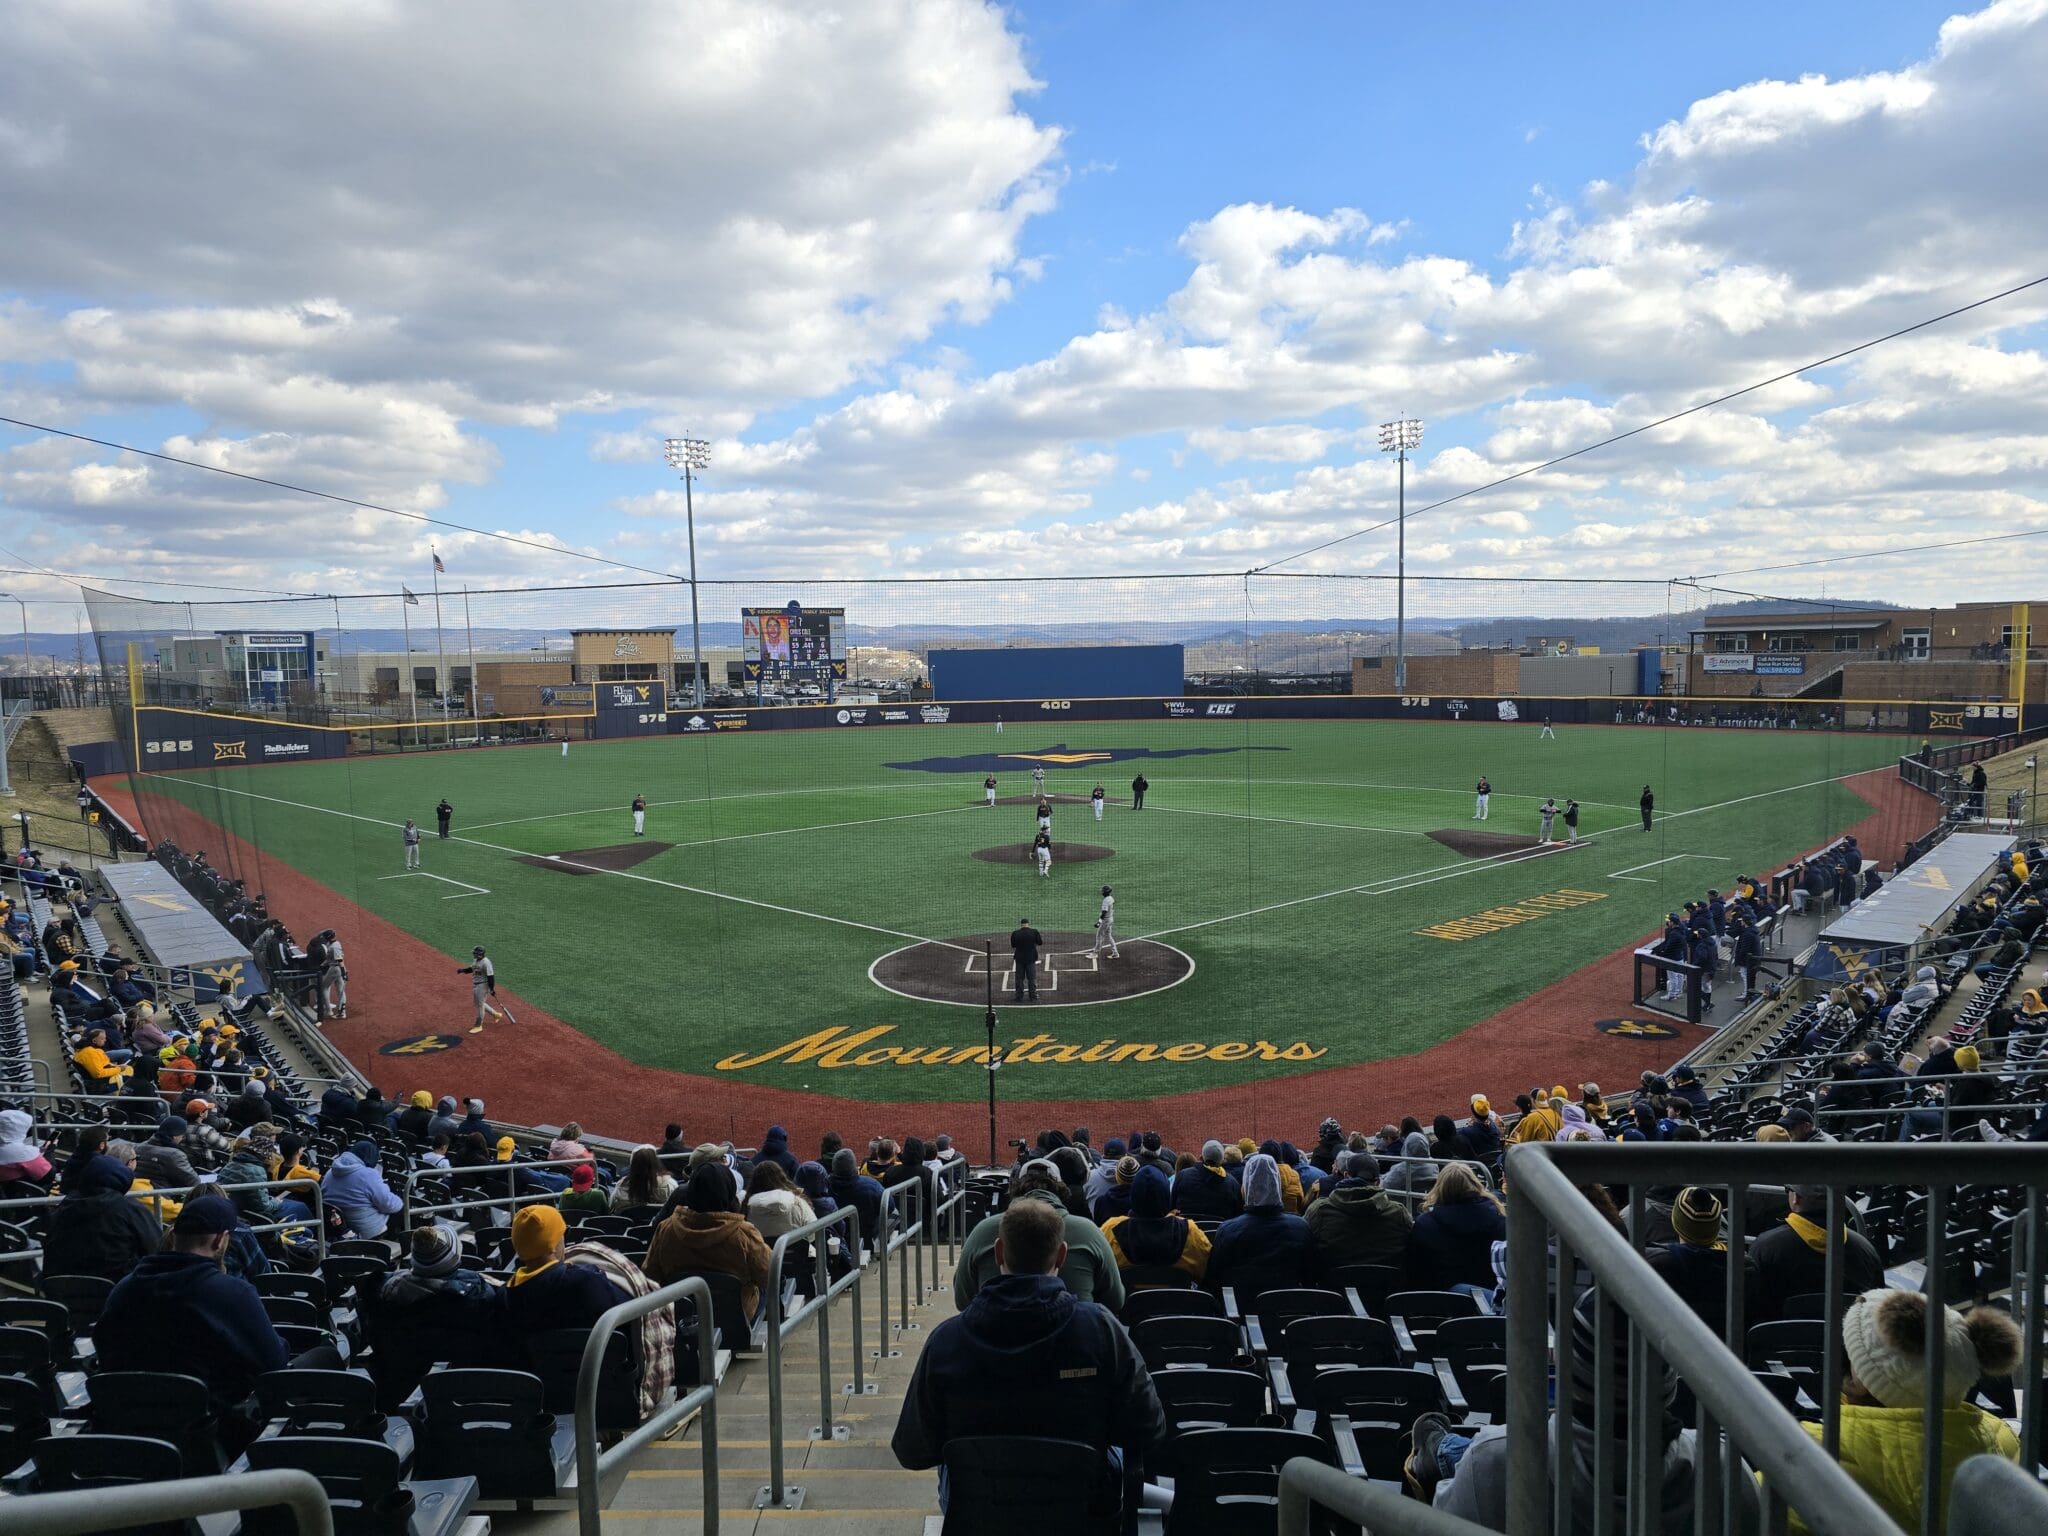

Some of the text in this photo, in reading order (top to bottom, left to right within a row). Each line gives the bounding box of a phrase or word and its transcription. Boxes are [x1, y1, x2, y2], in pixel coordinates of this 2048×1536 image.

[1040, 701, 1071, 710] 400
[1401, 697, 1430, 706] 375
[1965, 706, 2018, 718] 325
[639, 714, 667, 723] 375
[146, 740, 193, 753] 325
[264, 744, 309, 752] ReBuilders
[715, 1025, 1329, 1070] Mountaineers
